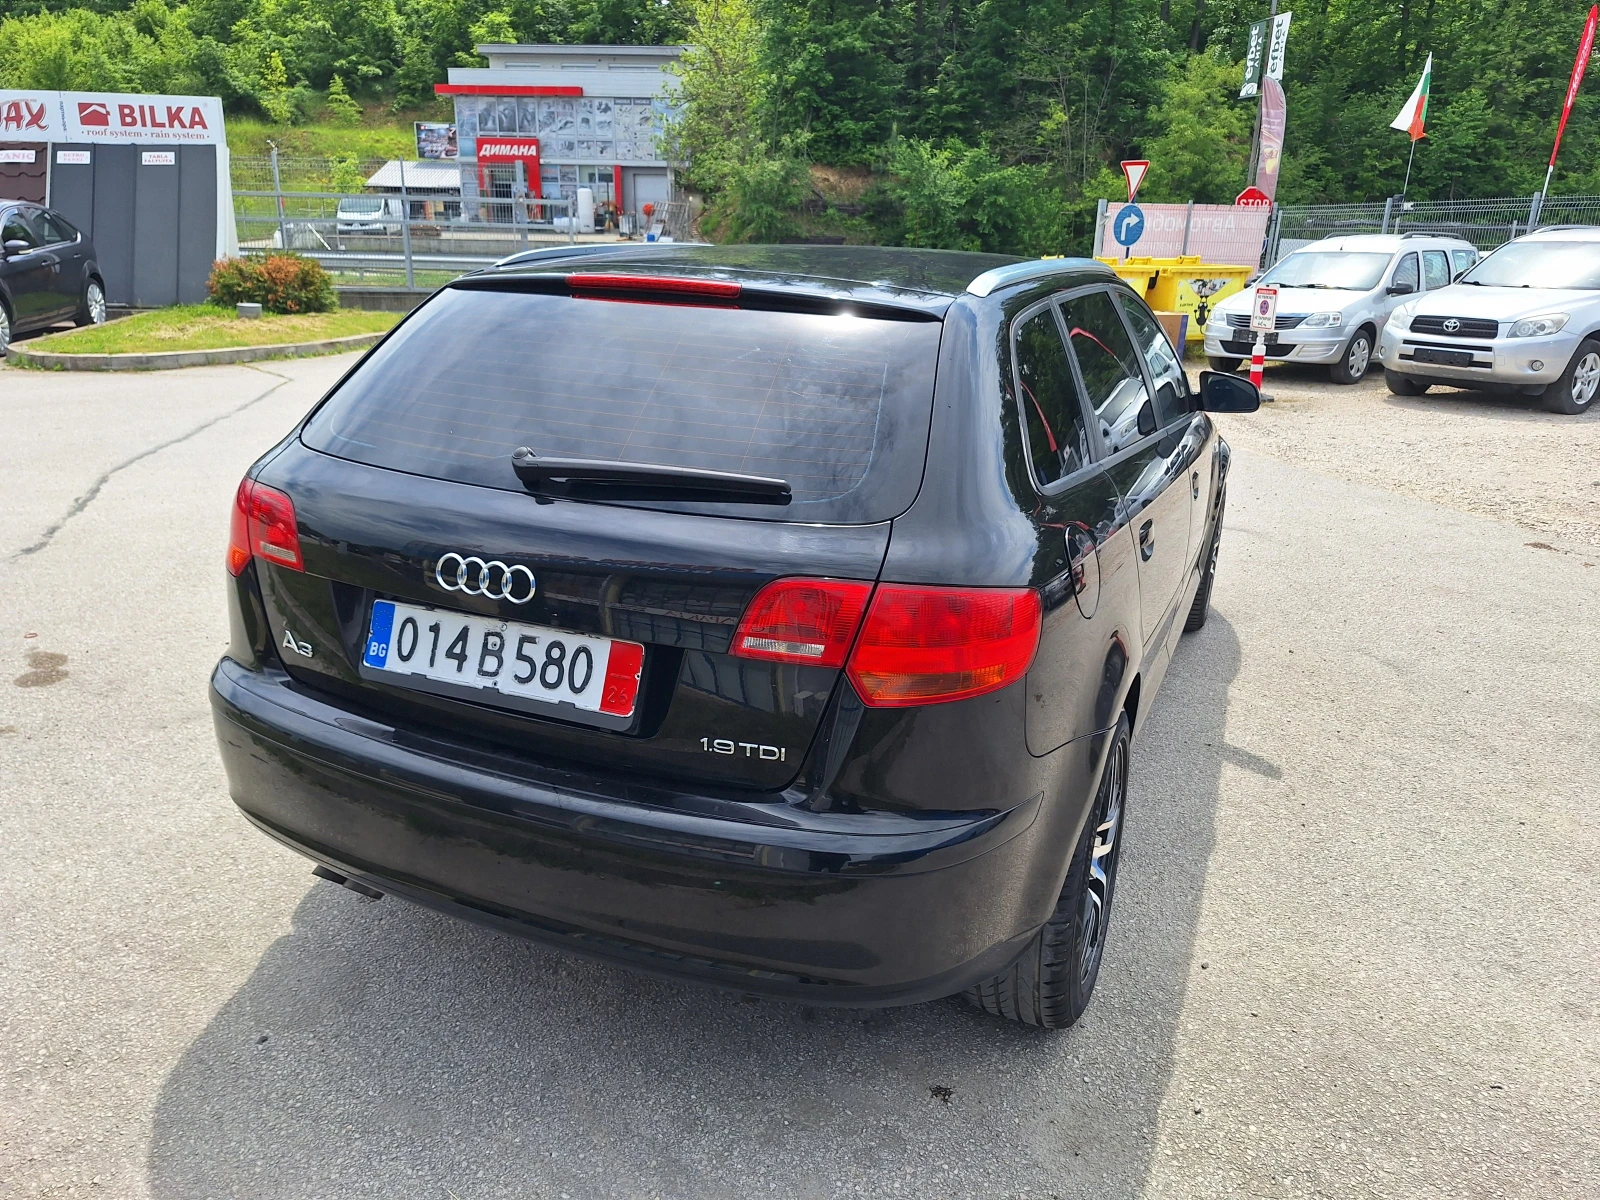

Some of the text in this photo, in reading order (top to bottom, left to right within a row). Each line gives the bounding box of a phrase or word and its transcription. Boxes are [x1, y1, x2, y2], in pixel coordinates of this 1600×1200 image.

[1245, 25, 1260, 81] efbet
[1270, 18, 1284, 74] efbet
[0, 101, 49, 132] AX
[118, 104, 208, 130] BILKA
[86, 128, 205, 140] roof system rain system
[479, 144, 537, 157] ДИМАНА
[282, 630, 313, 658] A3
[369, 641, 387, 657] BG
[700, 737, 786, 762] 1.9 TDI
